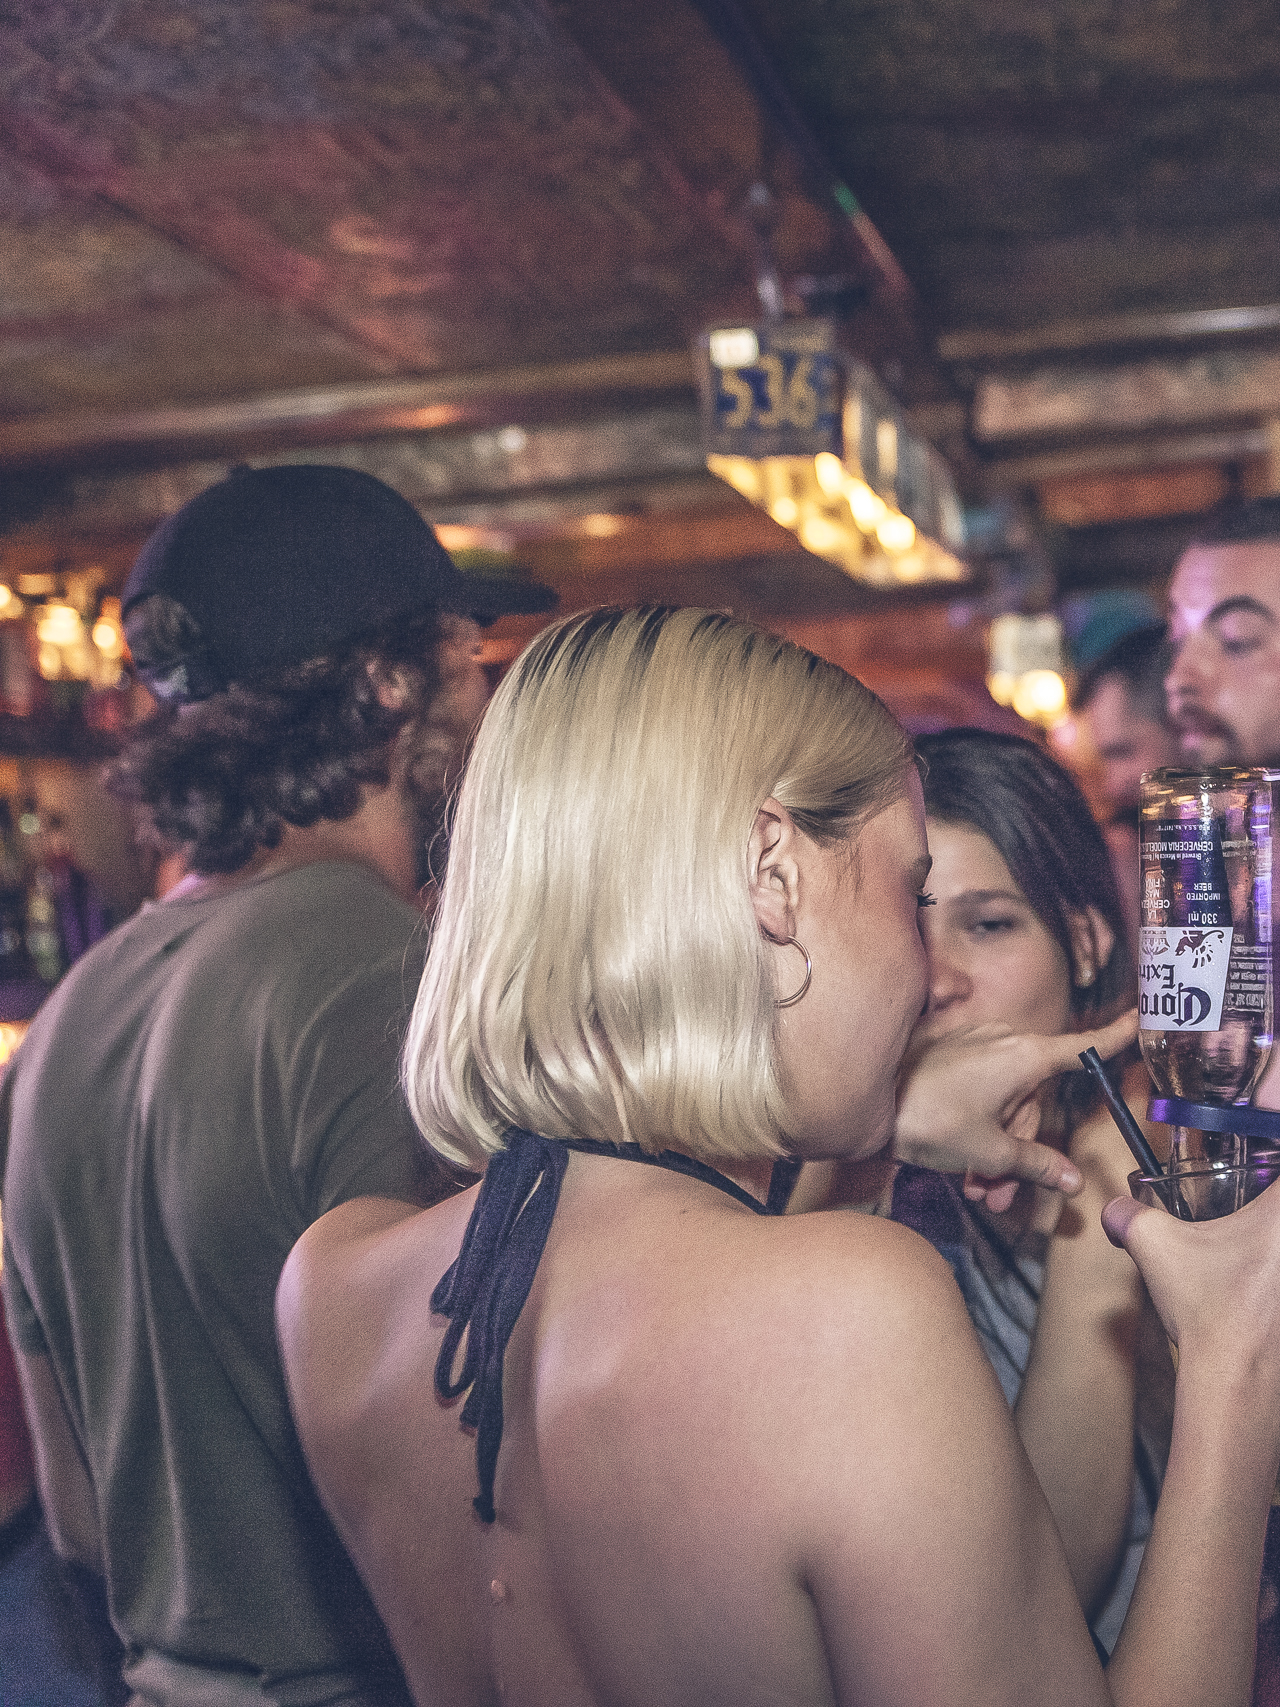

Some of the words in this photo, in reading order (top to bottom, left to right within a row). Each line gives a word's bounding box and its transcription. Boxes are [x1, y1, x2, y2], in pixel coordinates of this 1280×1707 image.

[1168, 841, 1214, 852] CERVECERIA
[1160, 853, 1176, 861] Mexico
[1182, 853, 1202, 861] Brewed
[1193, 882, 1212, 891] BEER
[1186, 892, 1221, 901] IMPORTED
[1147, 910, 1157, 919] LA
[1188, 913, 1199, 924] ml
[1201, 913, 1218, 924] 330
[1138, 964, 1176, 989] Extr
[1138, 982, 1212, 1027] Coro
